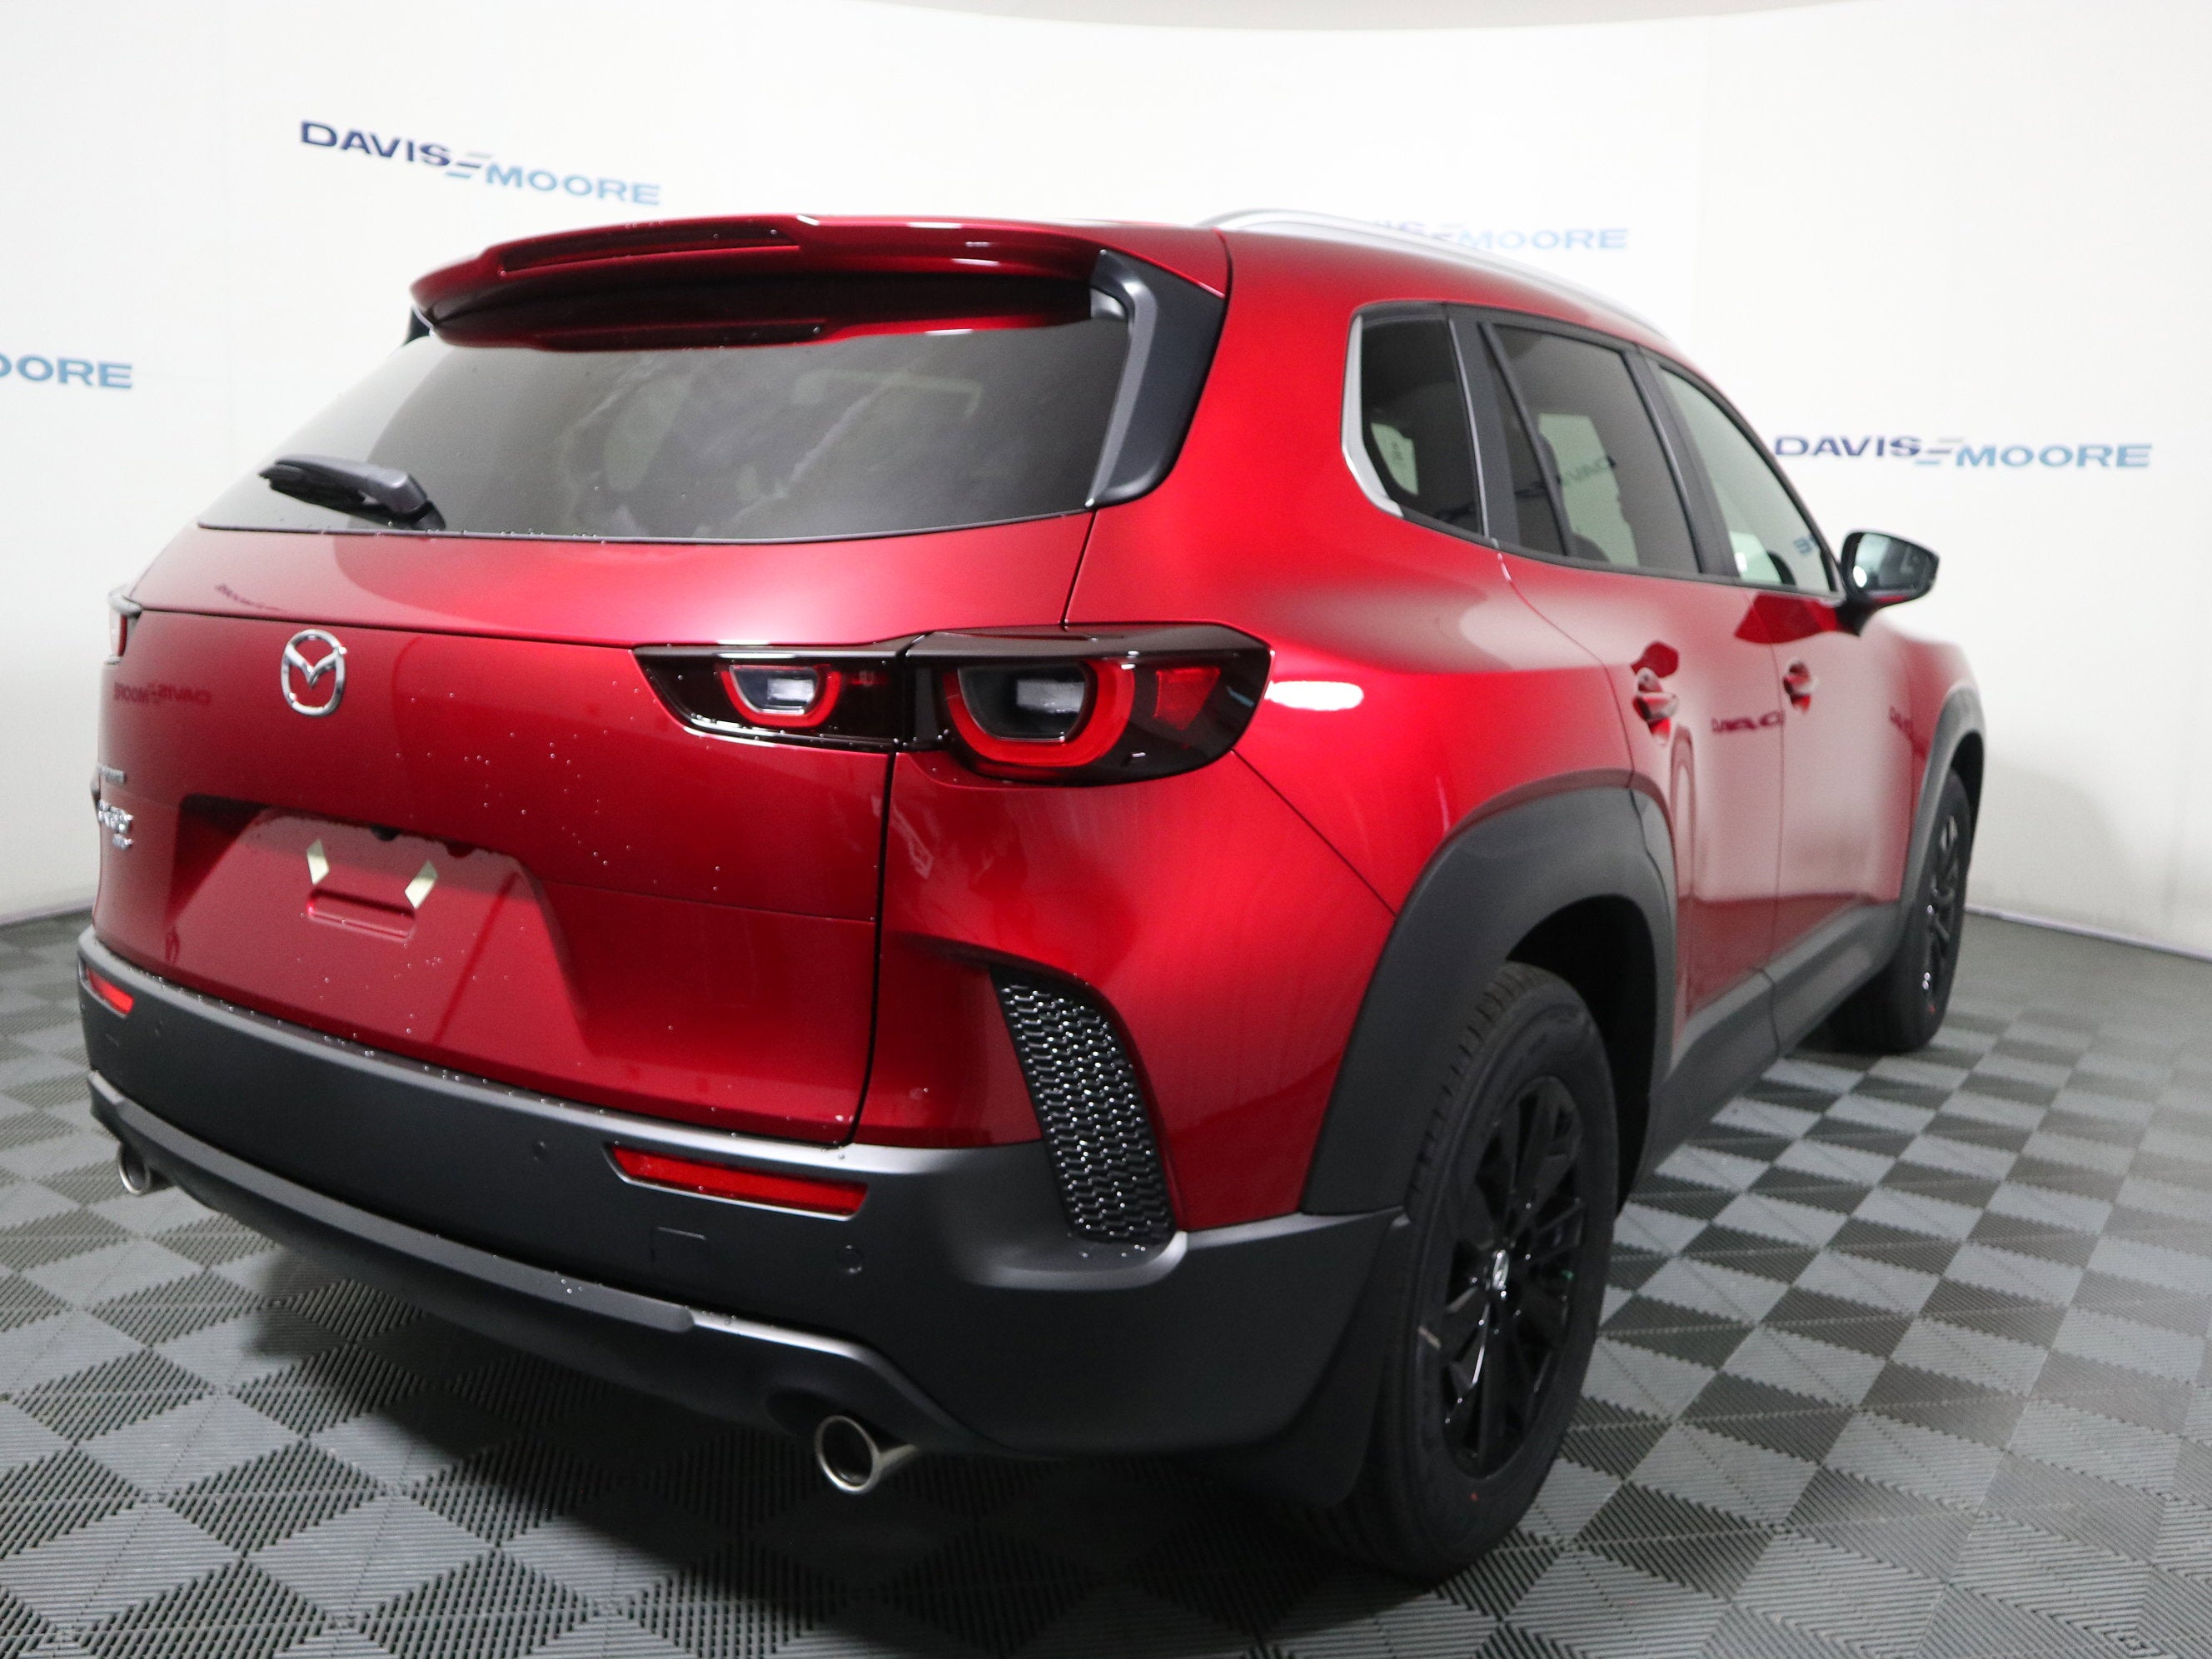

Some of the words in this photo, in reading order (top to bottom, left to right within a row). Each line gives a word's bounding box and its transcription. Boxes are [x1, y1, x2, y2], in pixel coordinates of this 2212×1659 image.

[301, 120, 451, 167] DAVIS
[486, 162, 661, 206] MOORE
[1458, 227, 1629, 250] MOORE
[1775, 435, 1921, 457] DAVIS
[1955, 442, 2153, 468] MOORE
